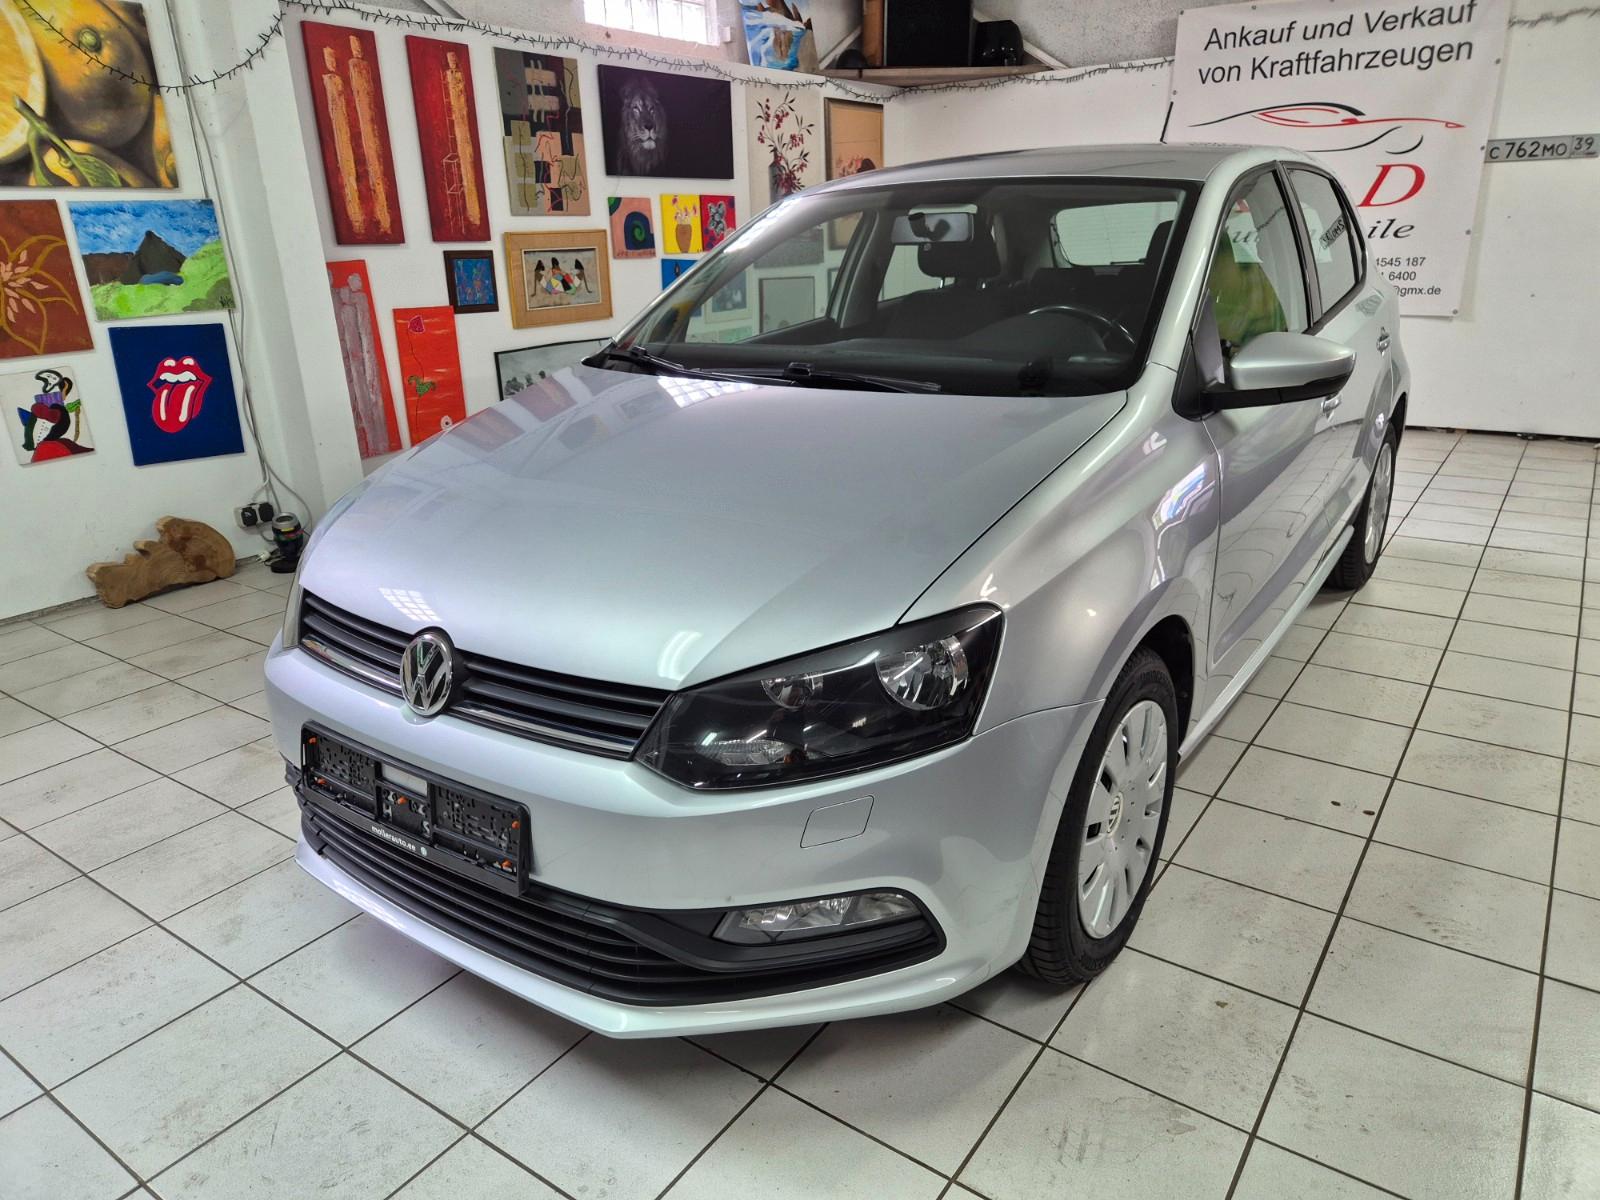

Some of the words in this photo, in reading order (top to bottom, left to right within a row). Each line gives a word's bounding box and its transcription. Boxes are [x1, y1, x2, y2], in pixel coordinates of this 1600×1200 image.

[1204, 20, 1297, 51] Ankauf
[1302, 14, 1353, 41] und
[1364, 0, 1477, 33] Verkauf
[1198, 64, 1241, 84] von
[1250, 40, 1473, 80] Kraftfahrzeugen
[1356, 164, 1425, 207] D
[1367, 218, 1415, 239] ile
[1388, 271, 1418, 281] 6400
[1406, 256, 1426, 267] 187
